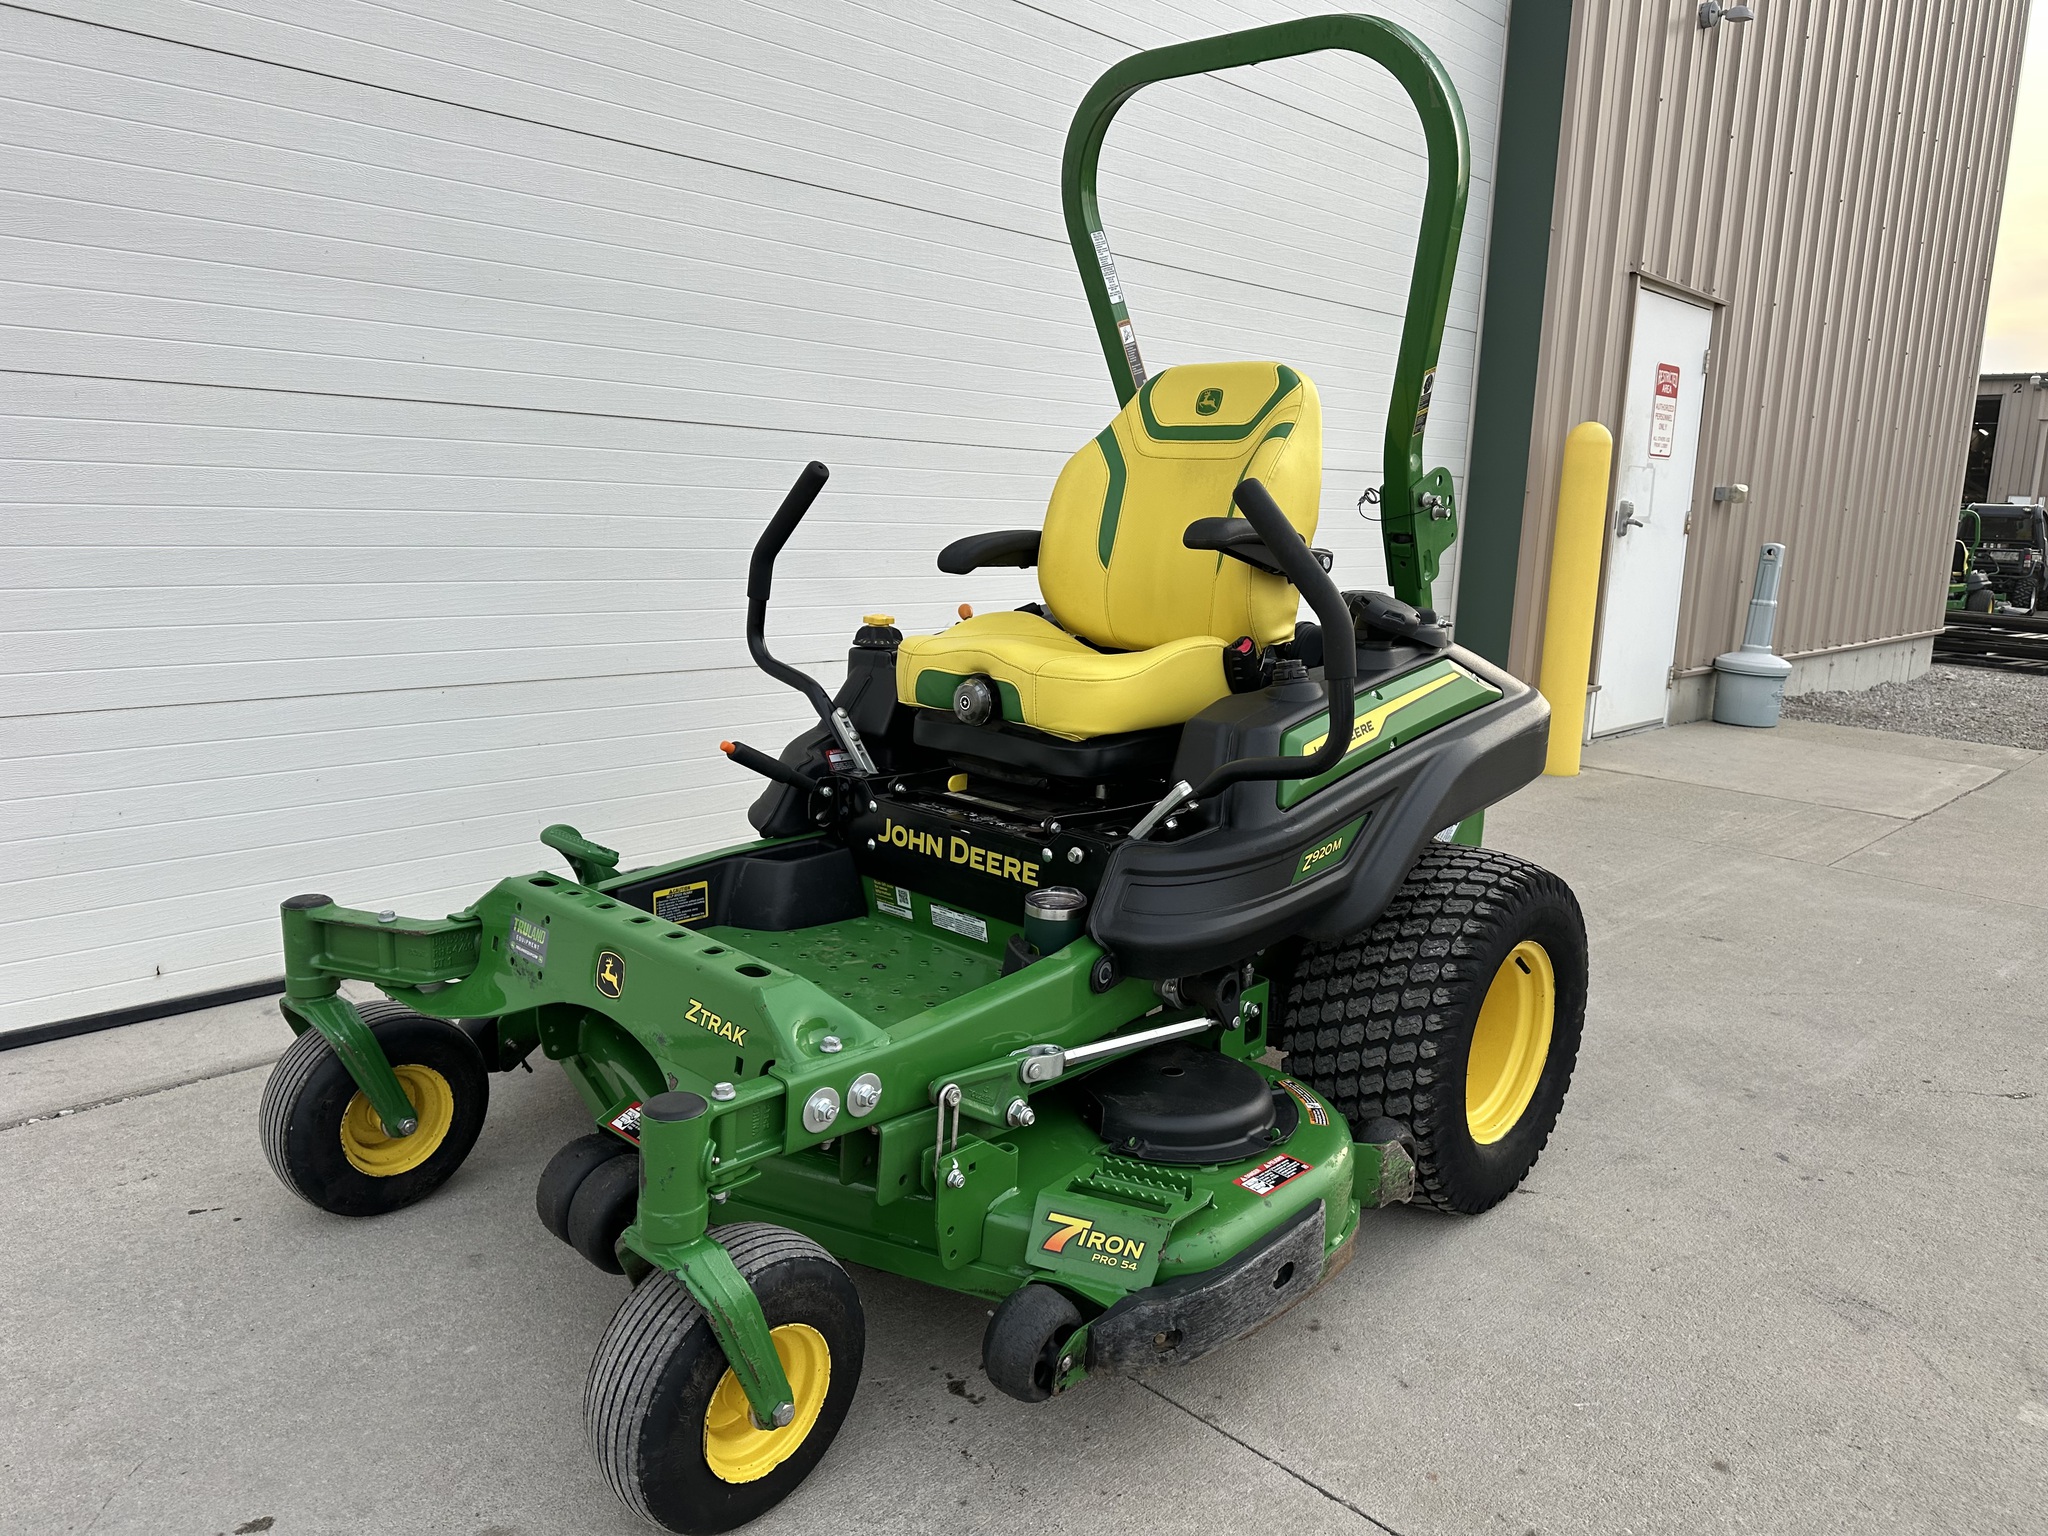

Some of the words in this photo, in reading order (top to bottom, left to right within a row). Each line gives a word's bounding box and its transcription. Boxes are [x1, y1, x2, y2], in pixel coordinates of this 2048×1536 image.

[1661, 384, 1673, 394] AREA
[2012, 383, 2023, 394] 2
[878, 818, 943, 859] JOHN
[949, 836, 1040, 887] DEERE
[1301, 836, 1343, 873] Z920M
[513, 917, 546, 945] TRULAND
[515, 934, 540, 950] EQUIPMENT
[684, 997, 749, 1048] ZTRAK
[1091, 1253, 1118, 1266] PRO
[1120, 1260, 1138, 1271] 54
